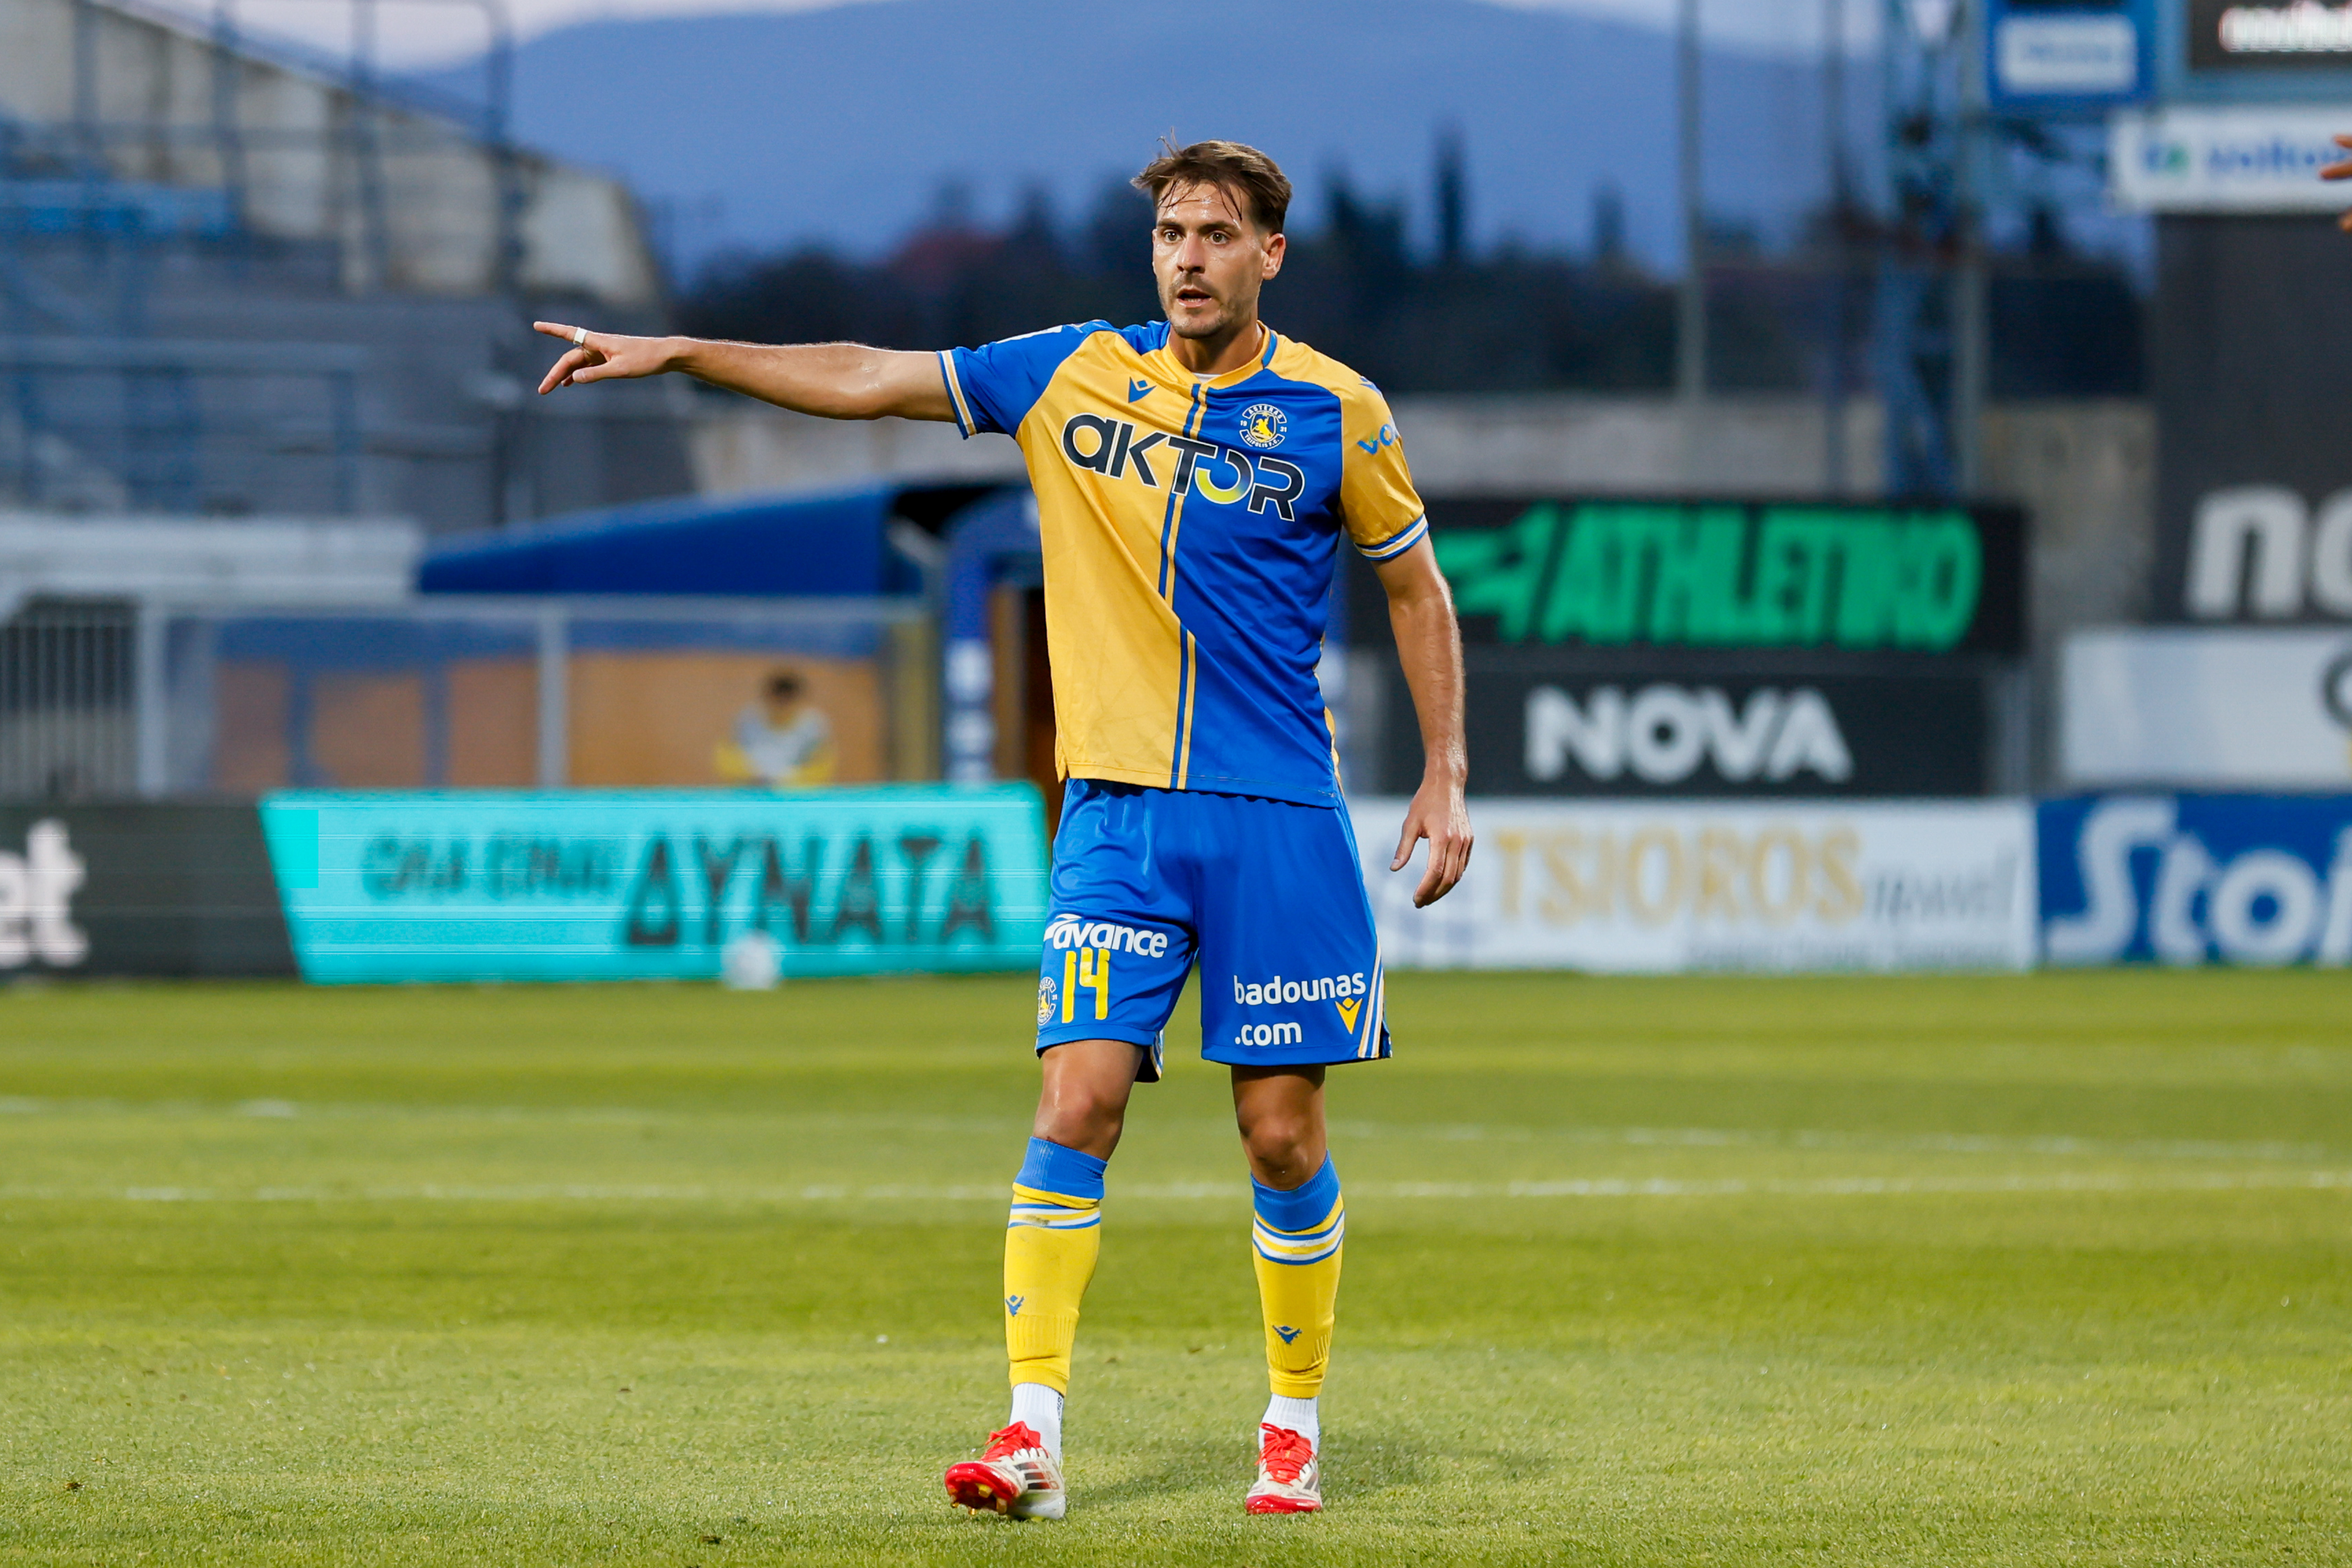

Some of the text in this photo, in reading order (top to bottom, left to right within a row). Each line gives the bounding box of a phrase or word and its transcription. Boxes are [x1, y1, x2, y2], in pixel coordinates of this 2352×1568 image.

[1249, 405, 1283, 419] ASTERAS
[1244, 434, 1268, 447] TRIPOLIS
[1357, 416, 1398, 455] vo
[1525, 685, 1852, 782] NOVA
[624, 830, 997, 947] ΔΥΝΑΤΑ
[1493, 826, 1864, 928] TSIOROS
[1061, 946, 1110, 1024] 14
[1234, 972, 1366, 1006] badounas
[1235, 1022, 1302, 1047] .com
